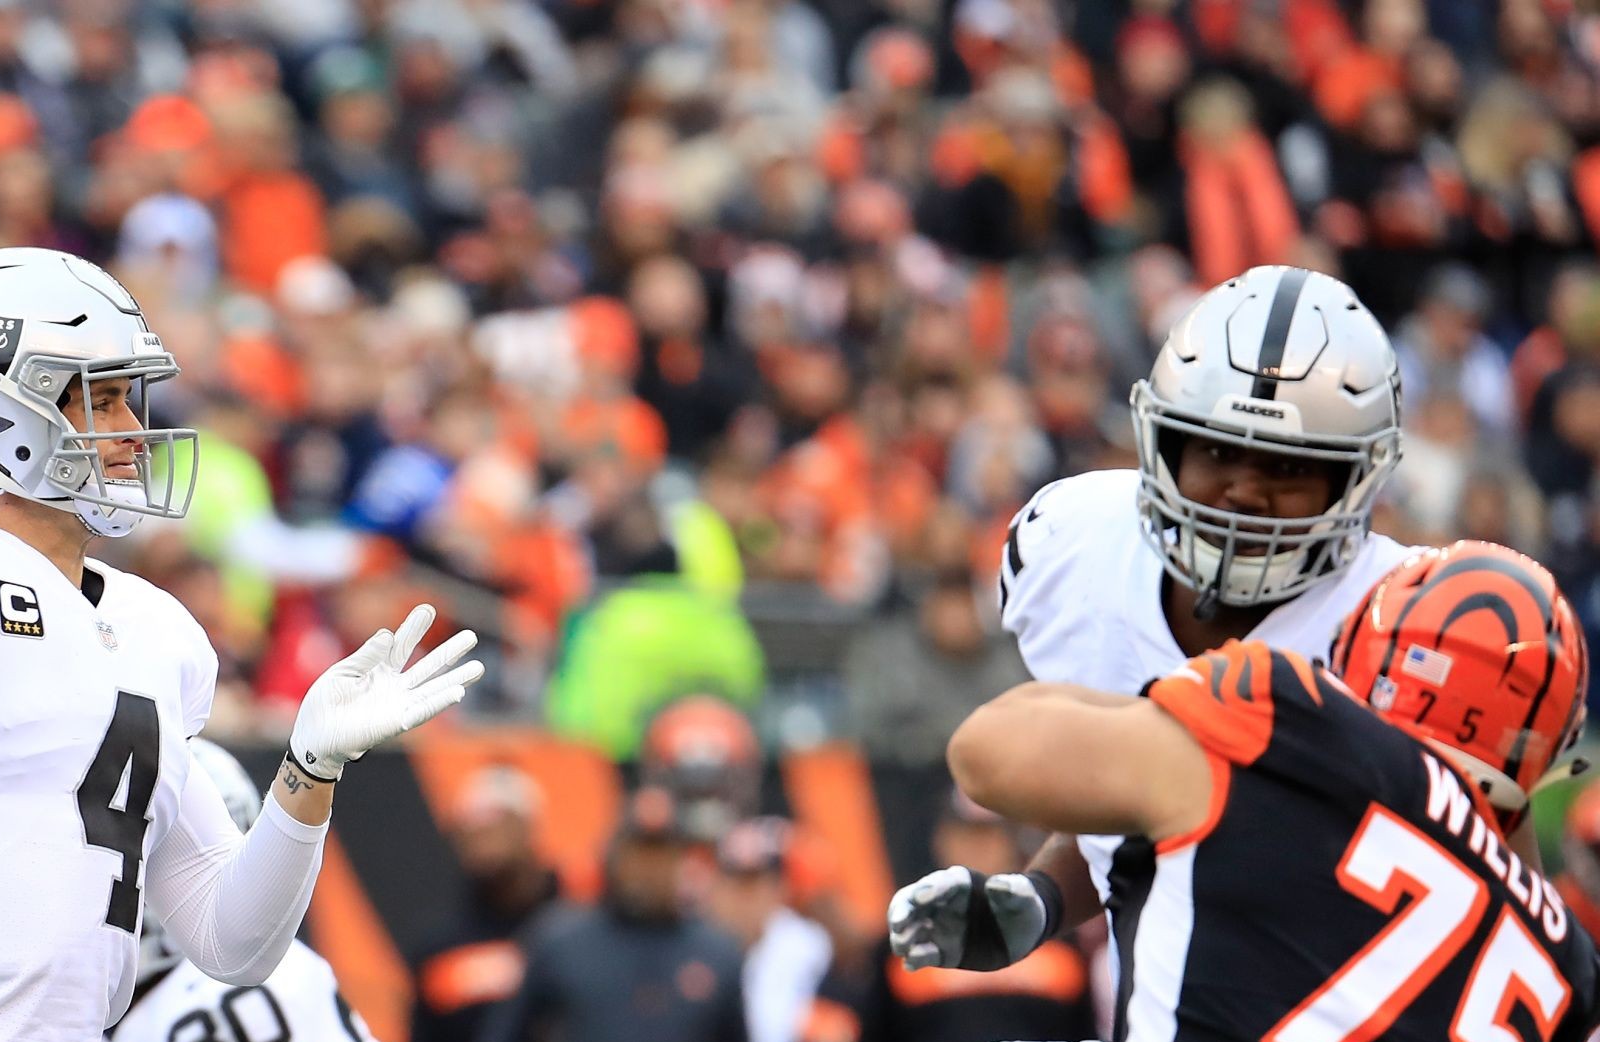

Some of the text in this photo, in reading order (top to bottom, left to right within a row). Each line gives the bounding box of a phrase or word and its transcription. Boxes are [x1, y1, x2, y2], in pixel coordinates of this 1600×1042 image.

[0, 583, 40, 624] C
[1415, 688, 1485, 744] 75
[76, 687, 162, 934] 4
[1421, 750, 1568, 943] WILLIS
